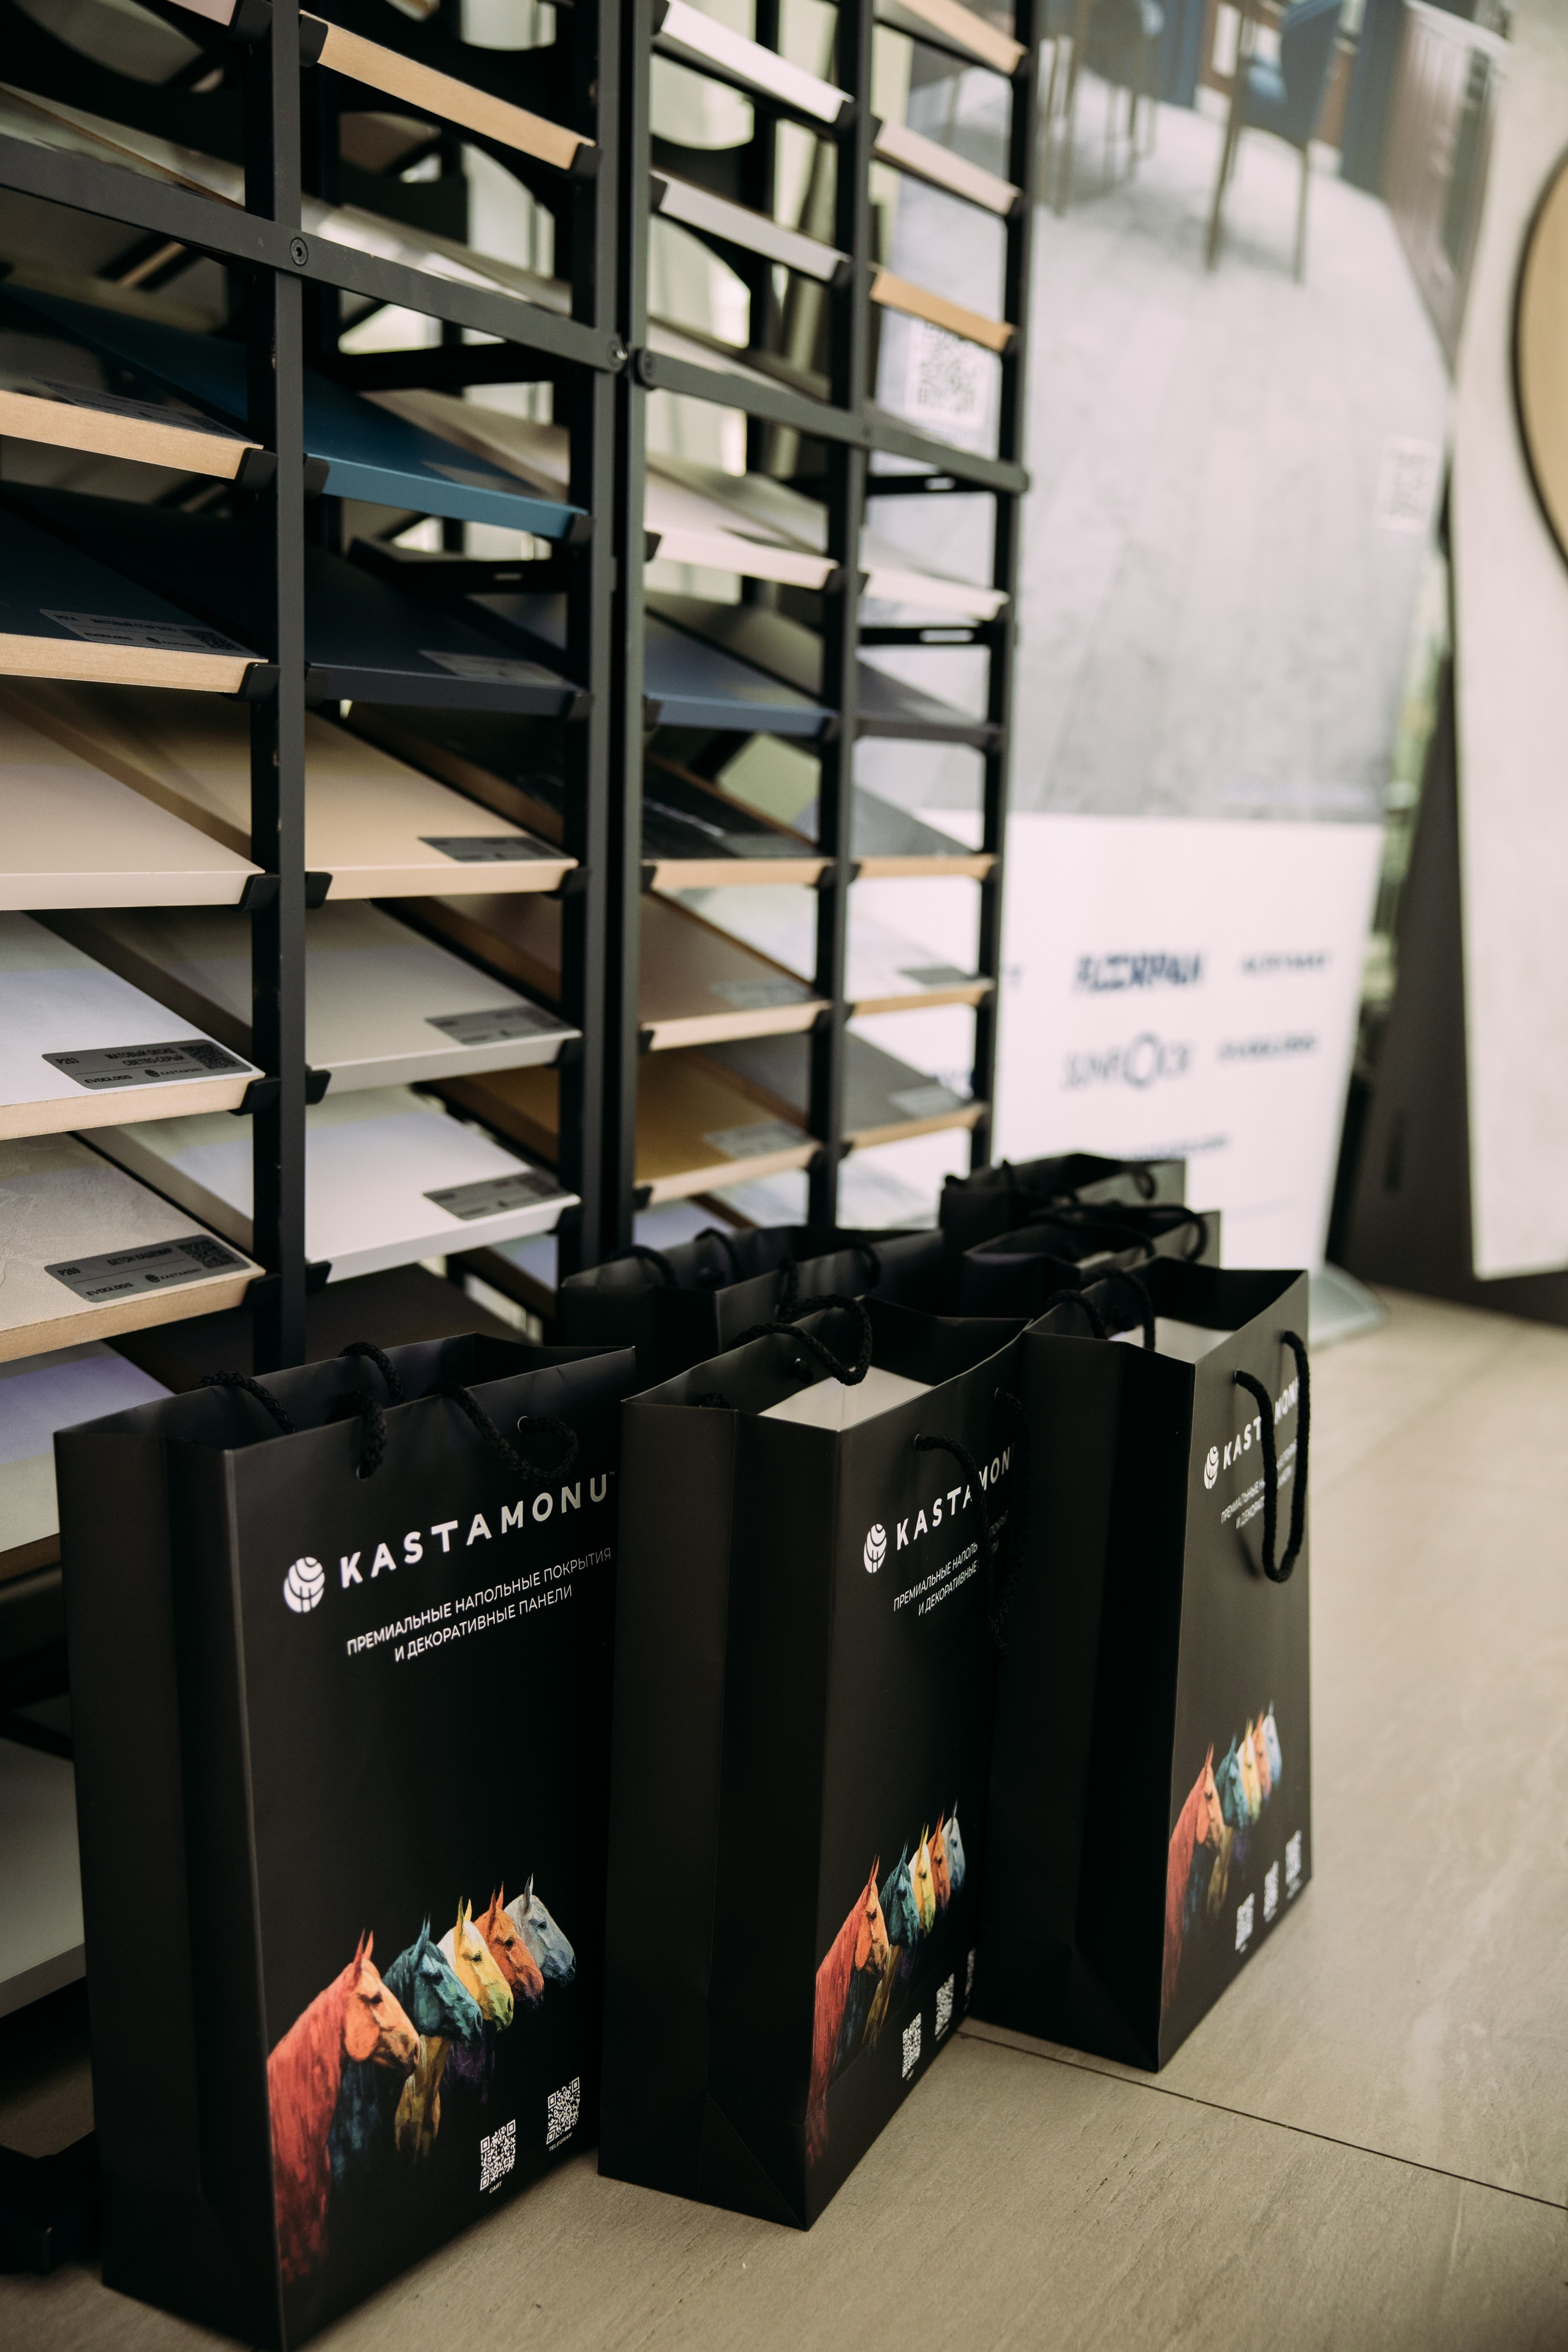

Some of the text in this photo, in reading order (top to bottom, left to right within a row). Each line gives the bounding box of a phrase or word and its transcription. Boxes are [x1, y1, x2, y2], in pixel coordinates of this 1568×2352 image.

[84, 1074, 133, 1084] EVOGLOSS
[86, 1282, 133, 1296] EVOGLOSS
[1224, 1376, 1298, 1469] KASTMON
[341, 1474, 606, 1588] KASTAMONU
[897, 1443, 1014, 1550] KASTAMON
[347, 1547, 611, 1656] ПРЕМИАЛЬНЫЕ НАПОЛЬНЫЕ ПОКРЫТИЯ
[894, 1561, 951, 1611] ПРЕМИАЛЬНЫЕ
[952, 1542, 978, 1570] НАПОЛЬ
[919, 1560, 977, 1616] И ДЕКОРАТИВНЫЕ
[395, 1584, 573, 1662] И ДЕКОРАТИВНЫЕ ПАНЕЛИ
[549, 2132, 573, 2152] TELEGRAM
[489, 2180, 502, 2194] САЙТ
